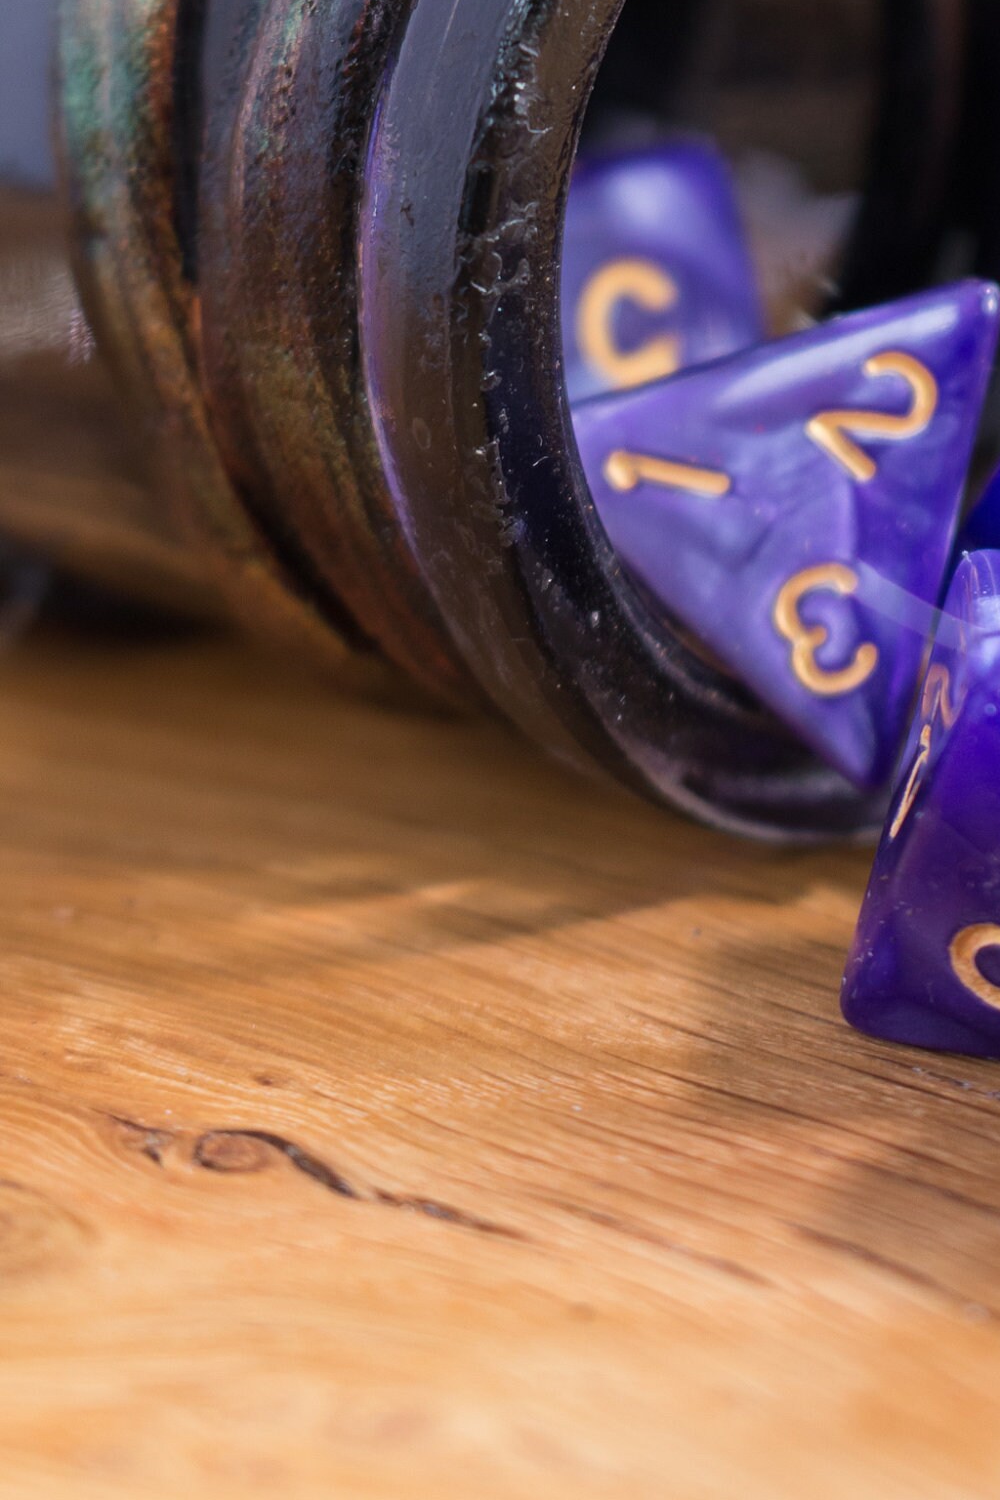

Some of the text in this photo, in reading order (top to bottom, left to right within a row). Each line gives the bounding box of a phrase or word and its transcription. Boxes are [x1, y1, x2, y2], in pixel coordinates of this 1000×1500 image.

[605, 449, 731, 495] 1
[805, 351, 937, 481] 2
[773, 562, 878, 694] 3
